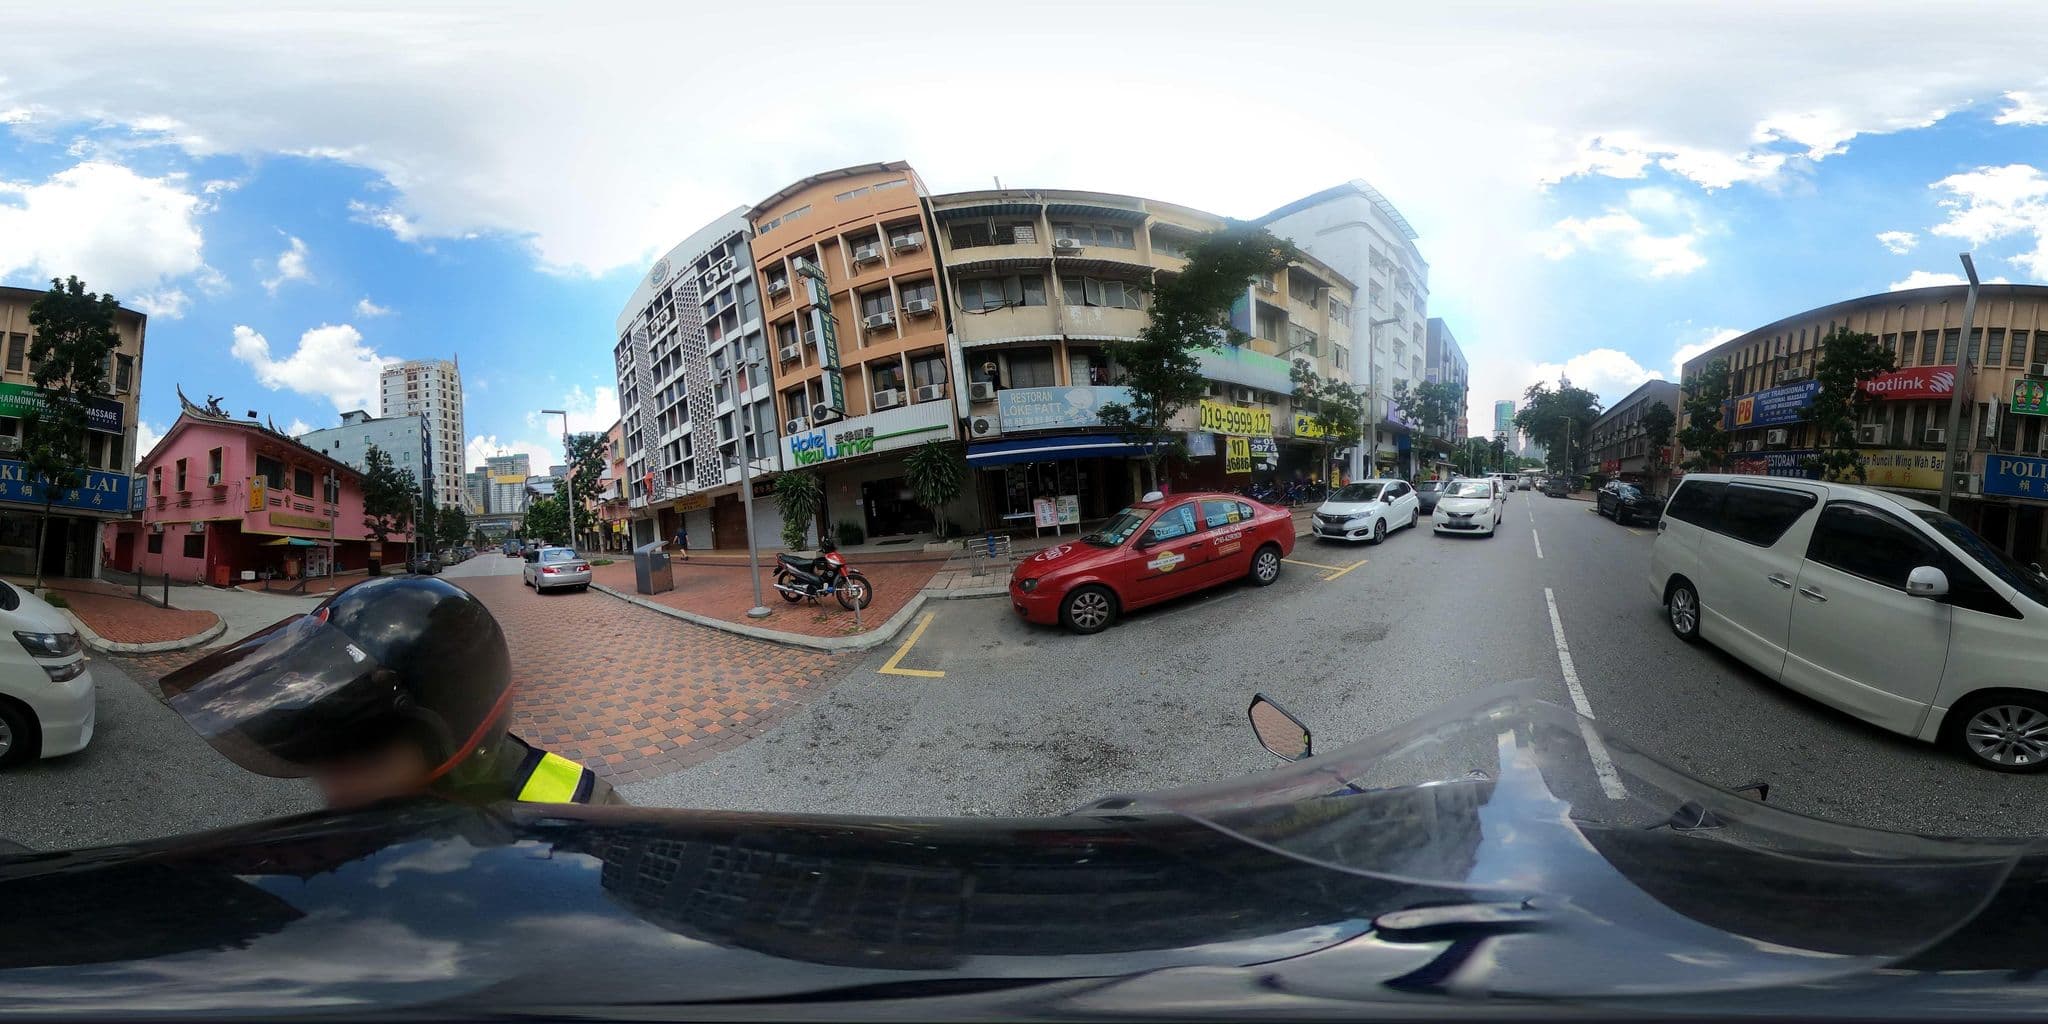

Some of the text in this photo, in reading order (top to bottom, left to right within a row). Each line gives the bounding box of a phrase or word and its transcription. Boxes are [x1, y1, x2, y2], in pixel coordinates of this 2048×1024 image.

[1866, 376, 1925, 392] hotlink
[1009, 391, 1054, 404] RESTORAN
[1002, 402, 1064, 418] LOKE FATT
[1737, 400, 1753, 424] PB
[791, 428, 826, 454] Hotel
[794, 433, 874, 467] New Winner
[1871, 455, 1892, 467] Runcit
[1895, 455, 1912, 471] Wing
[1914, 456, 1929, 468] Wah
[85, 474, 118, 493] LAI
